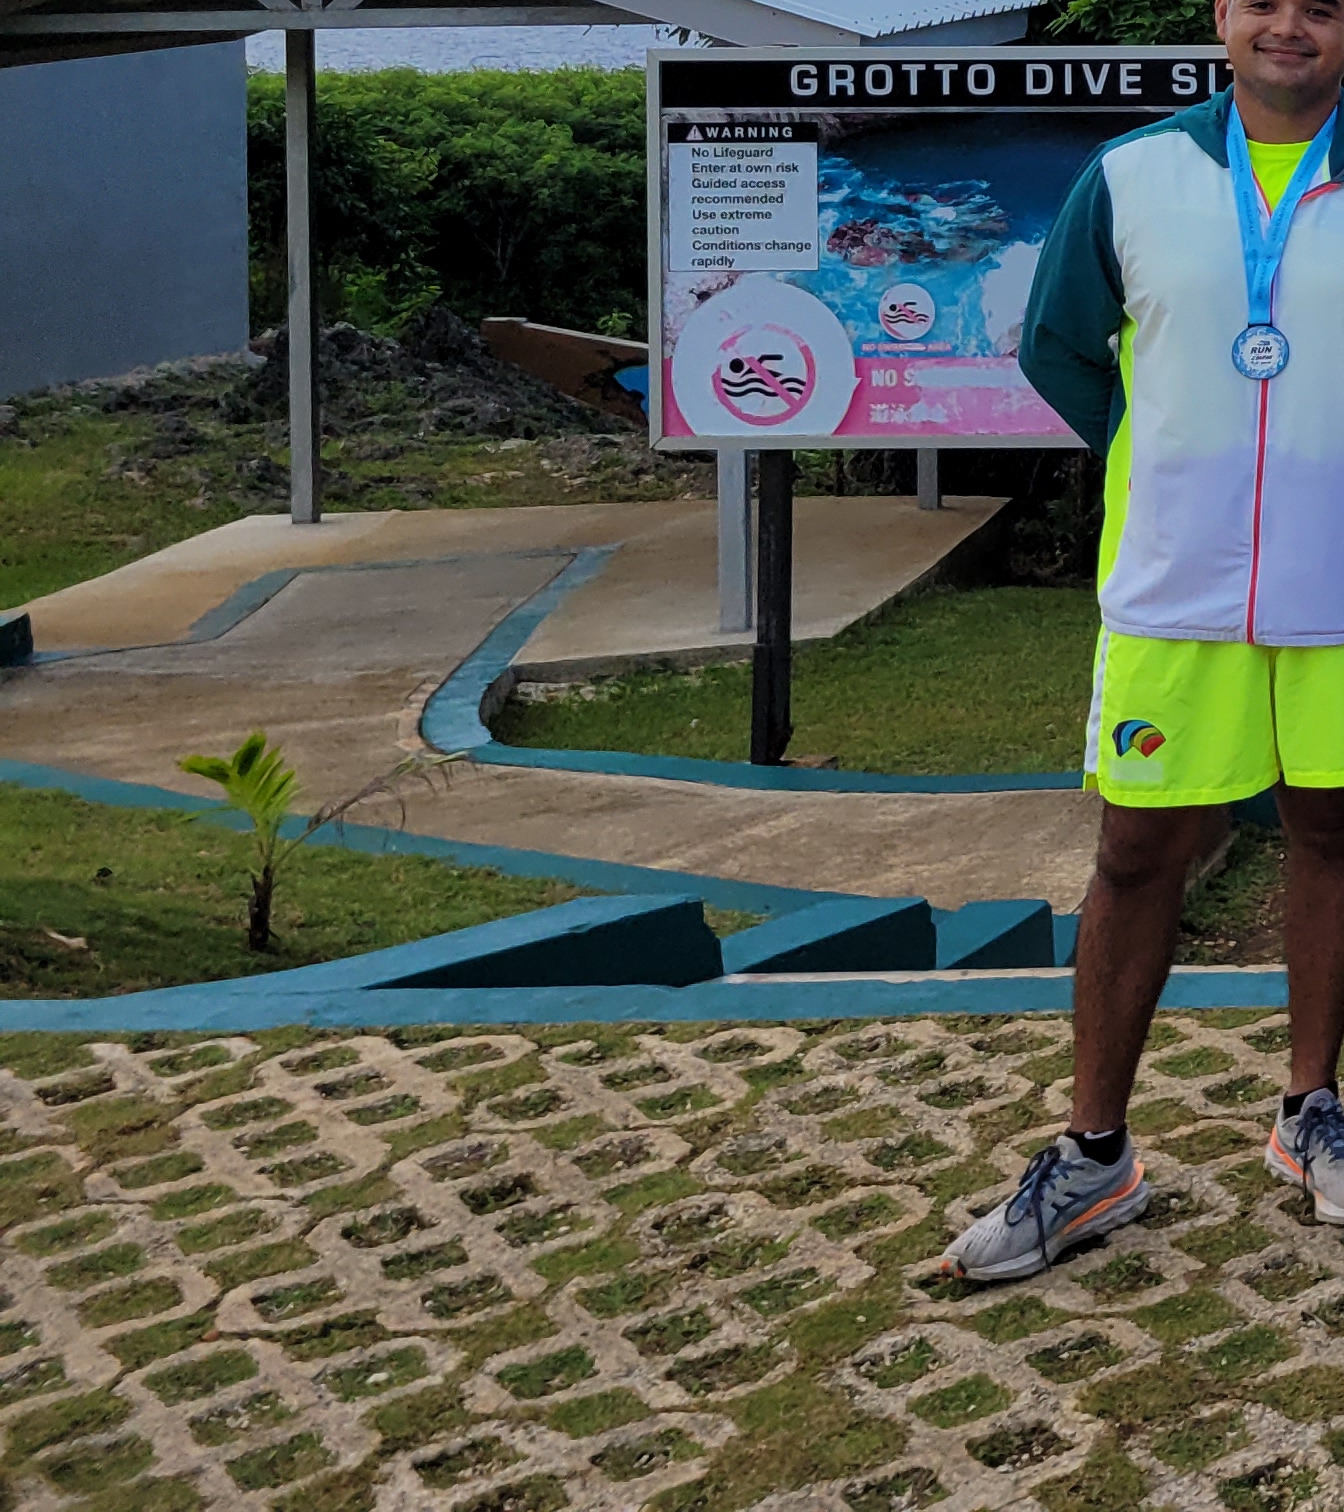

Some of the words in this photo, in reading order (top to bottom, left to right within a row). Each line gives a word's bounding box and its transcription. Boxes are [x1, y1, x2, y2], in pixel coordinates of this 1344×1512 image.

[791, 64, 996, 96] GROTTO
[1026, 64, 1143, 96] DIVE
[705, 126, 793, 138] WARNING
[691, 147, 709, 158] No
[713, 147, 774, 159] Lifeguard
[691, 163, 727, 173] Enter
[729, 163, 742, 173] at
[746, 165, 772, 173] own
[776, 162, 799, 173] risk
[691, 178, 737, 189] Guided
[740, 180, 786, 189] access
[691, 193, 784, 204] recommended
[692, 209, 717, 220] Use
[720, 210, 773, 220] extreme
[691, 225, 740, 235] caution
[692, 240, 761, 251] Conditions
[765, 240, 812, 252] change
[691, 256, 735, 268] rapidly
[1250, 346, 1273, 355] RUN
[871, 370, 897, 387] NO
